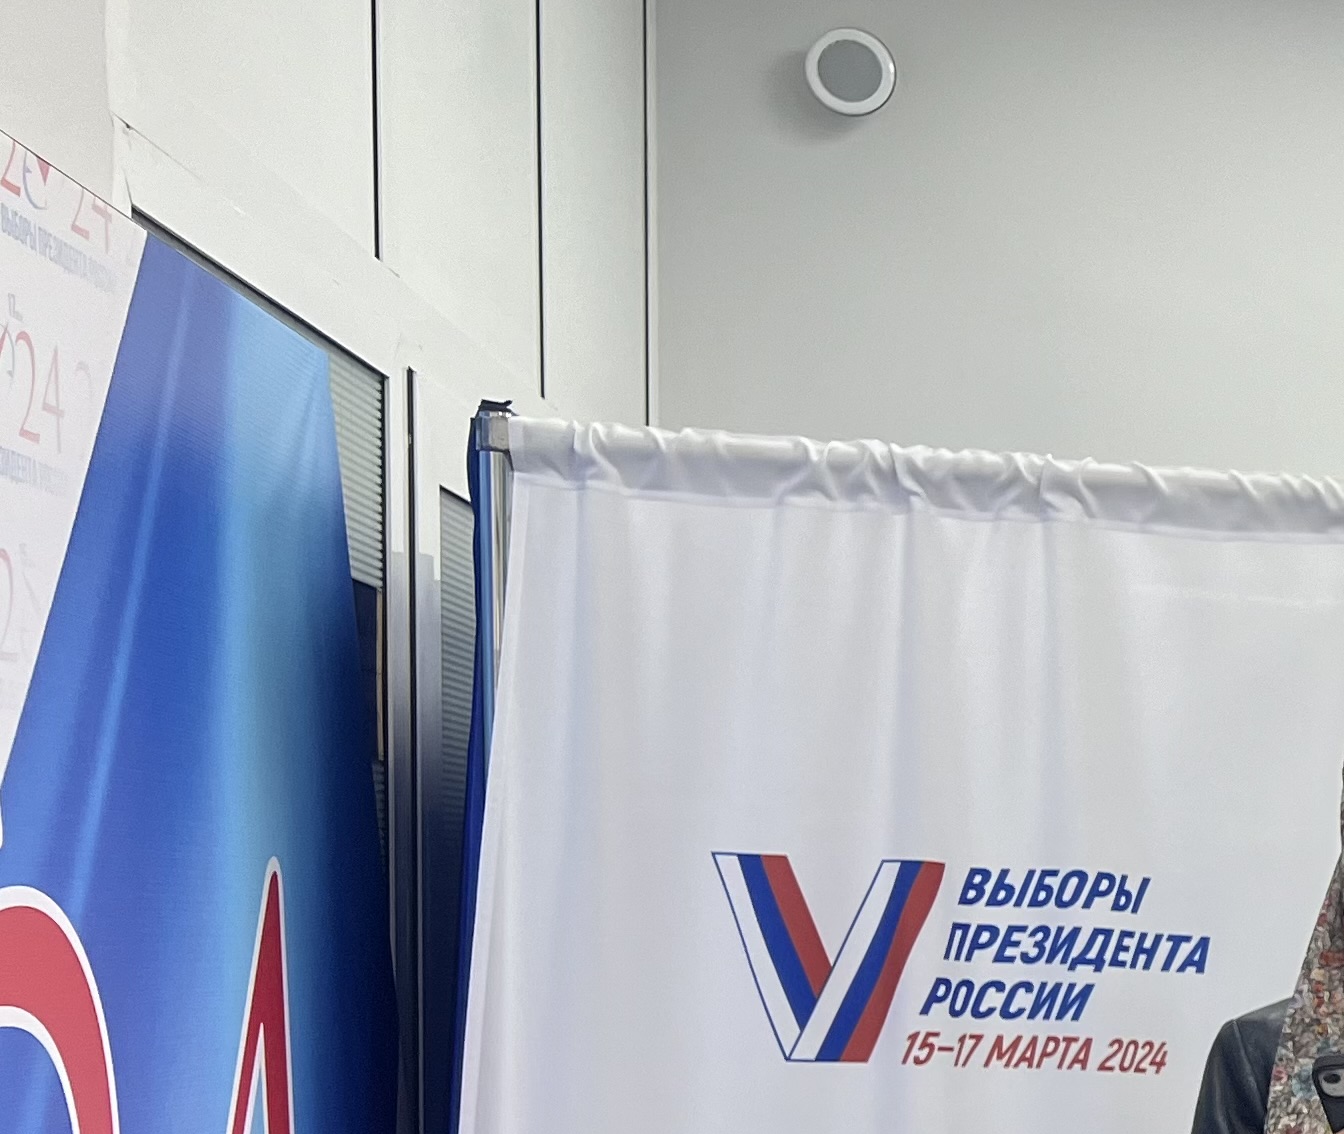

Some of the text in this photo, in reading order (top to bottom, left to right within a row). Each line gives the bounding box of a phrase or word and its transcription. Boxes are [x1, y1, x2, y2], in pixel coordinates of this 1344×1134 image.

[958, 867, 1152, 914] ВЫБОРЫ
[944, 922, 1211, 974] ПРЕЗИДЕНТА
[920, 977, 1095, 1021] РОССИИ
[984, 1037, 1091, 1069] МАРТА
[1098, 1038, 1168, 1074] 2024
